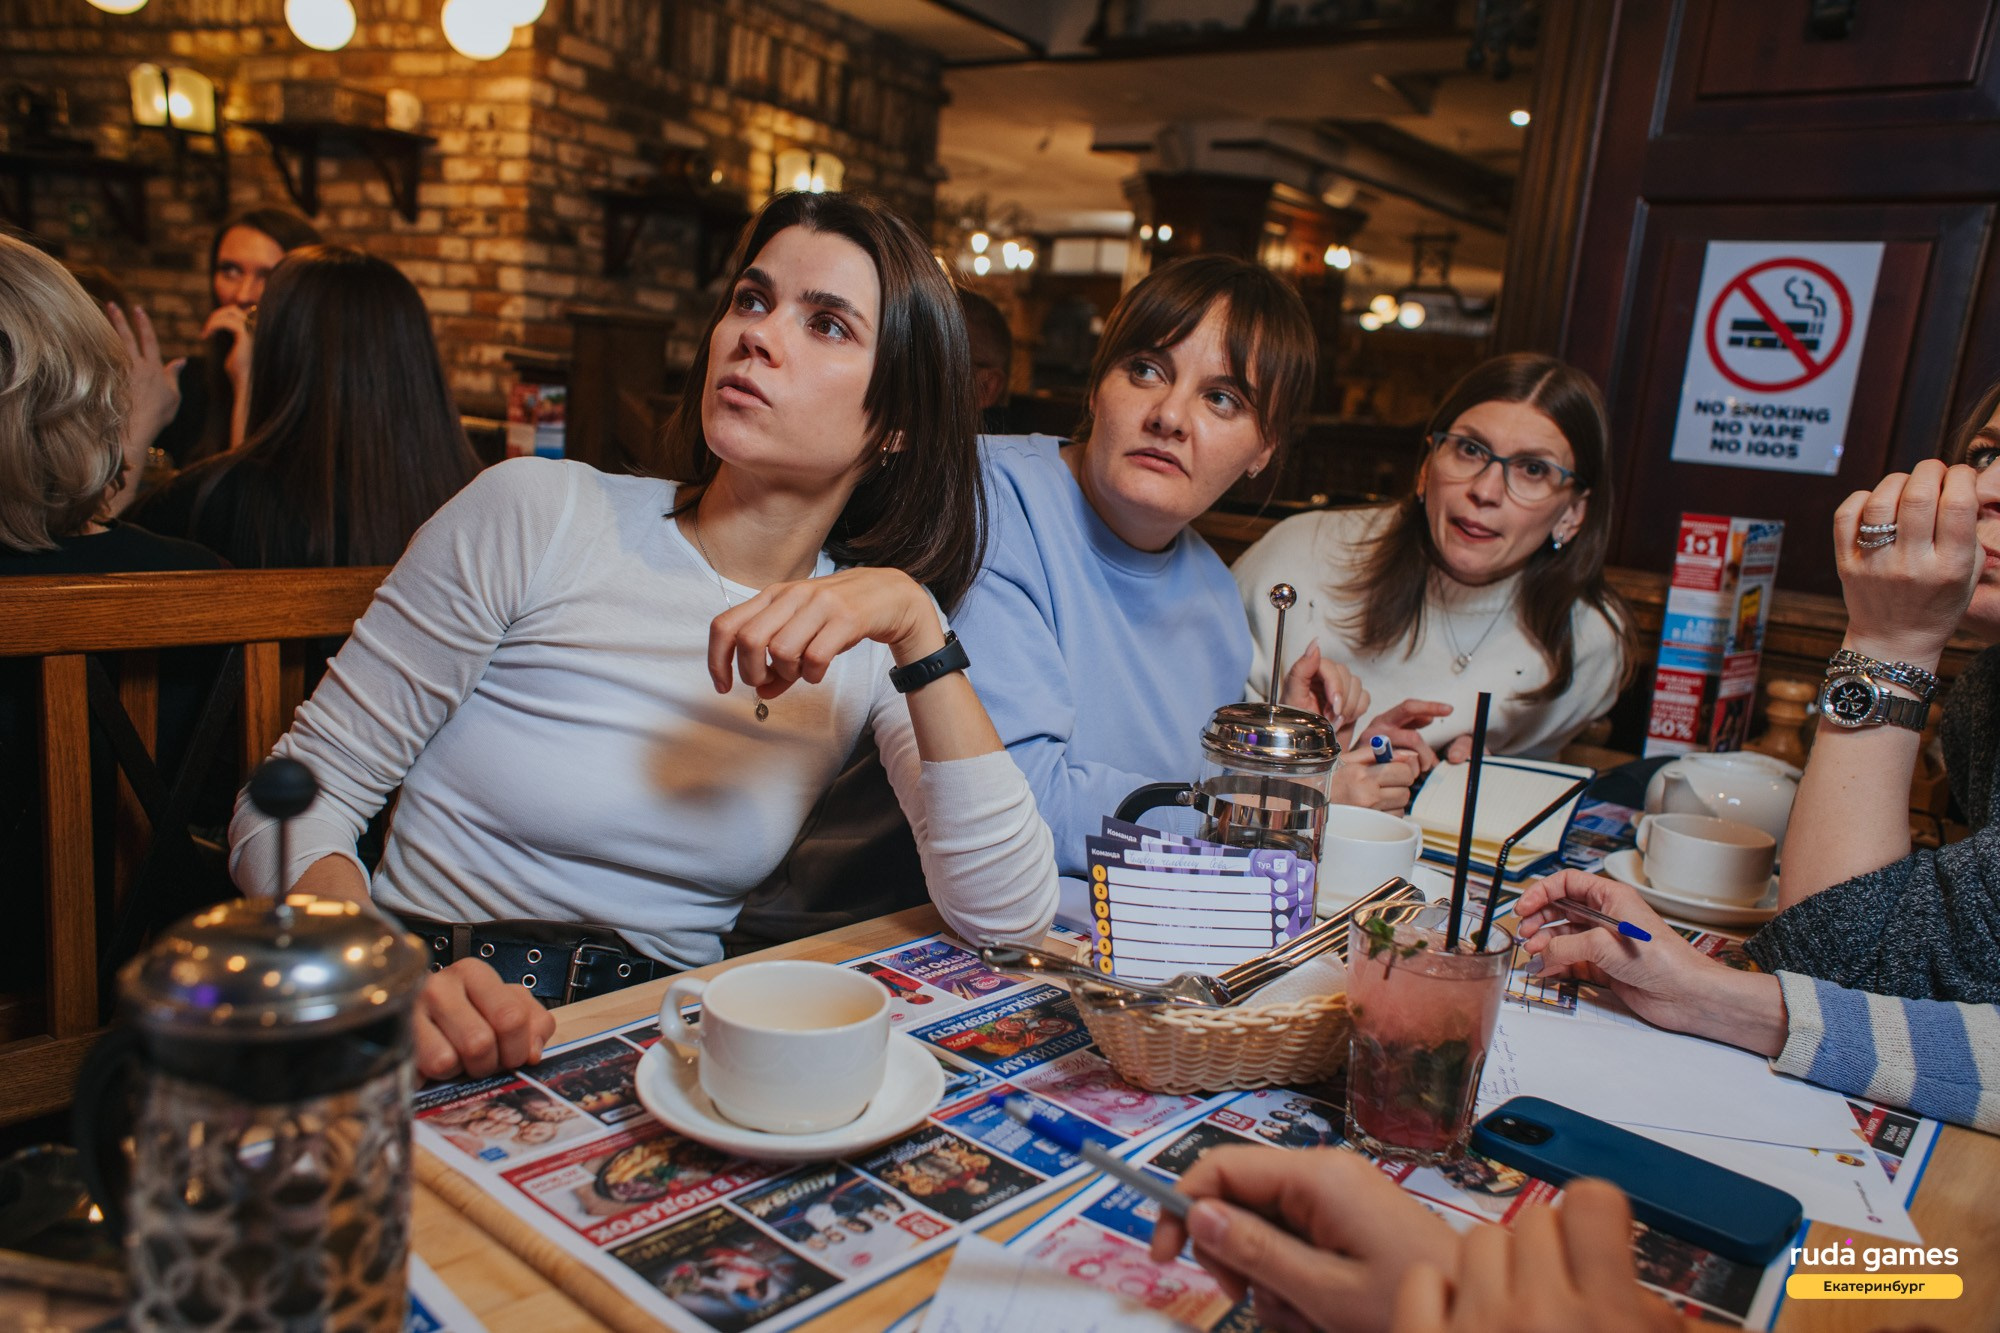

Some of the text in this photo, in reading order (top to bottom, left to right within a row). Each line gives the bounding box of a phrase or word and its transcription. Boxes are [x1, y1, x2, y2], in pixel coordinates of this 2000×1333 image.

[1695, 400, 1831, 424] NO SMOKING
[1712, 420, 1804, 440] NO VAPE
[1711, 438, 1799, 459] NO IQOS
[1684, 534, 1719, 556] 1+1
[1107, 827, 1138, 843] Команда
[1091, 848, 1121, 859] Команда
[1256, 860, 1271, 870] Тур
[994, 1030, 1092, 1075] ИННИКАМ
[588, 1185, 715, 1241] ПОДАРОК
